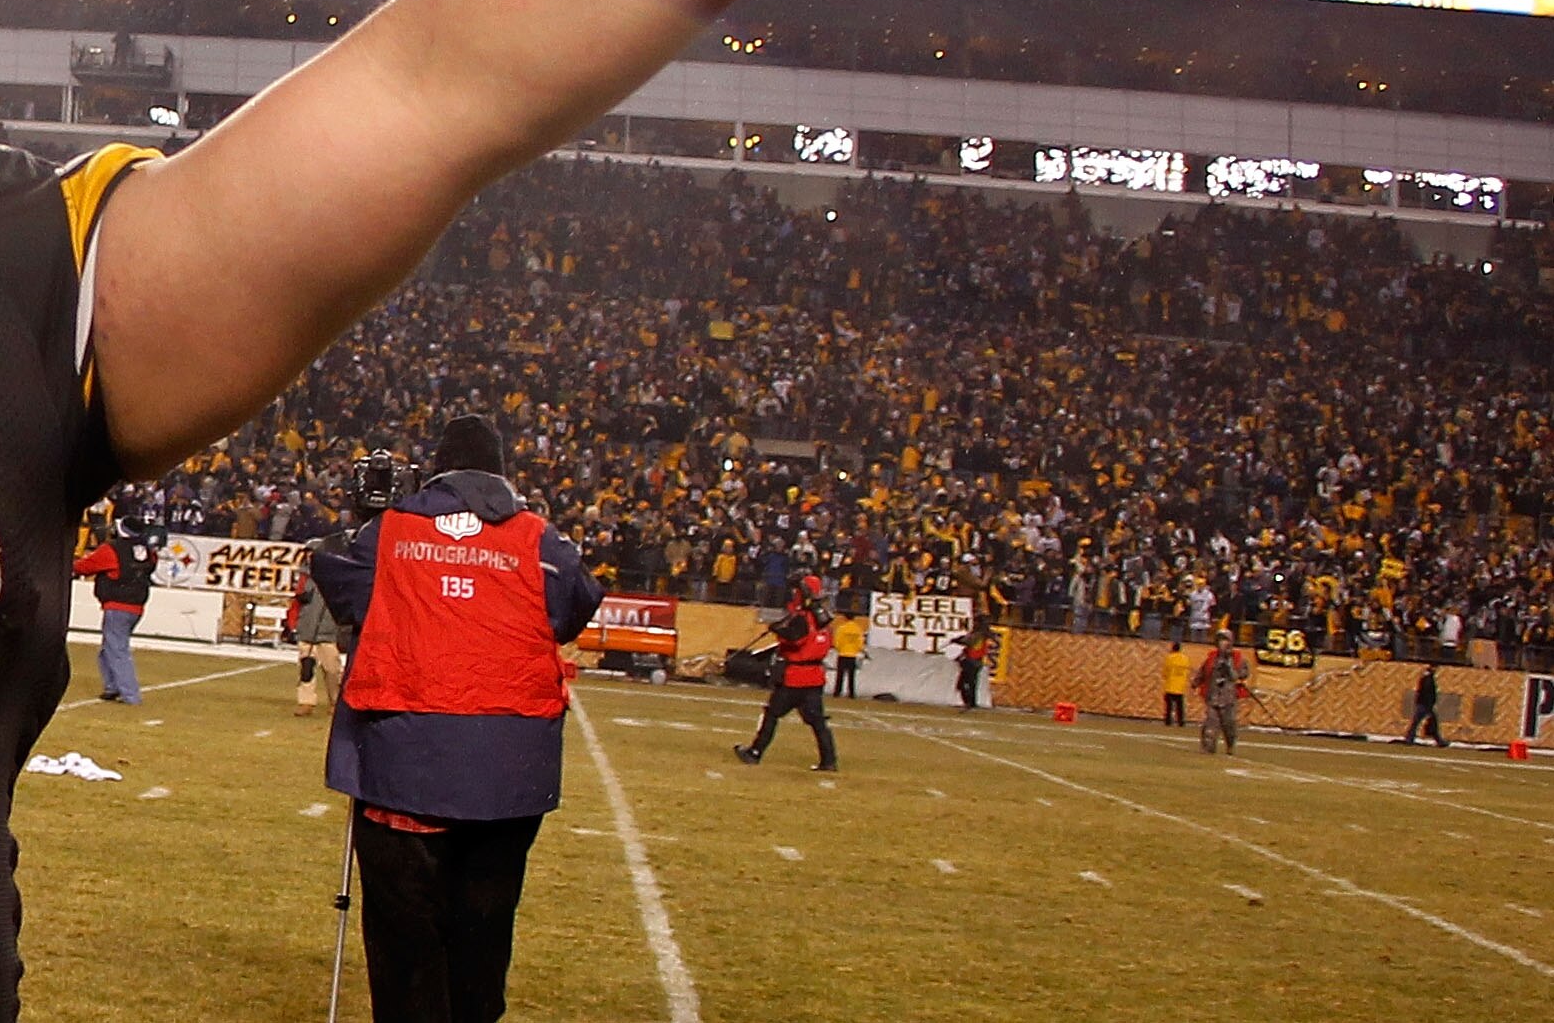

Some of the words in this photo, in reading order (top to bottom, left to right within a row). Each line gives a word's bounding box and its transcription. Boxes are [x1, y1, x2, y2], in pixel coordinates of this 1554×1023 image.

[442, 513, 476, 530] NFL
[395, 541, 519, 572] PHOTOGRAPHER
[441, 575, 474, 599] 135
[877, 593, 966, 615] STEEL
[873, 611, 969, 632] CURTAIN
[1267, 628, 1306, 651] 56
